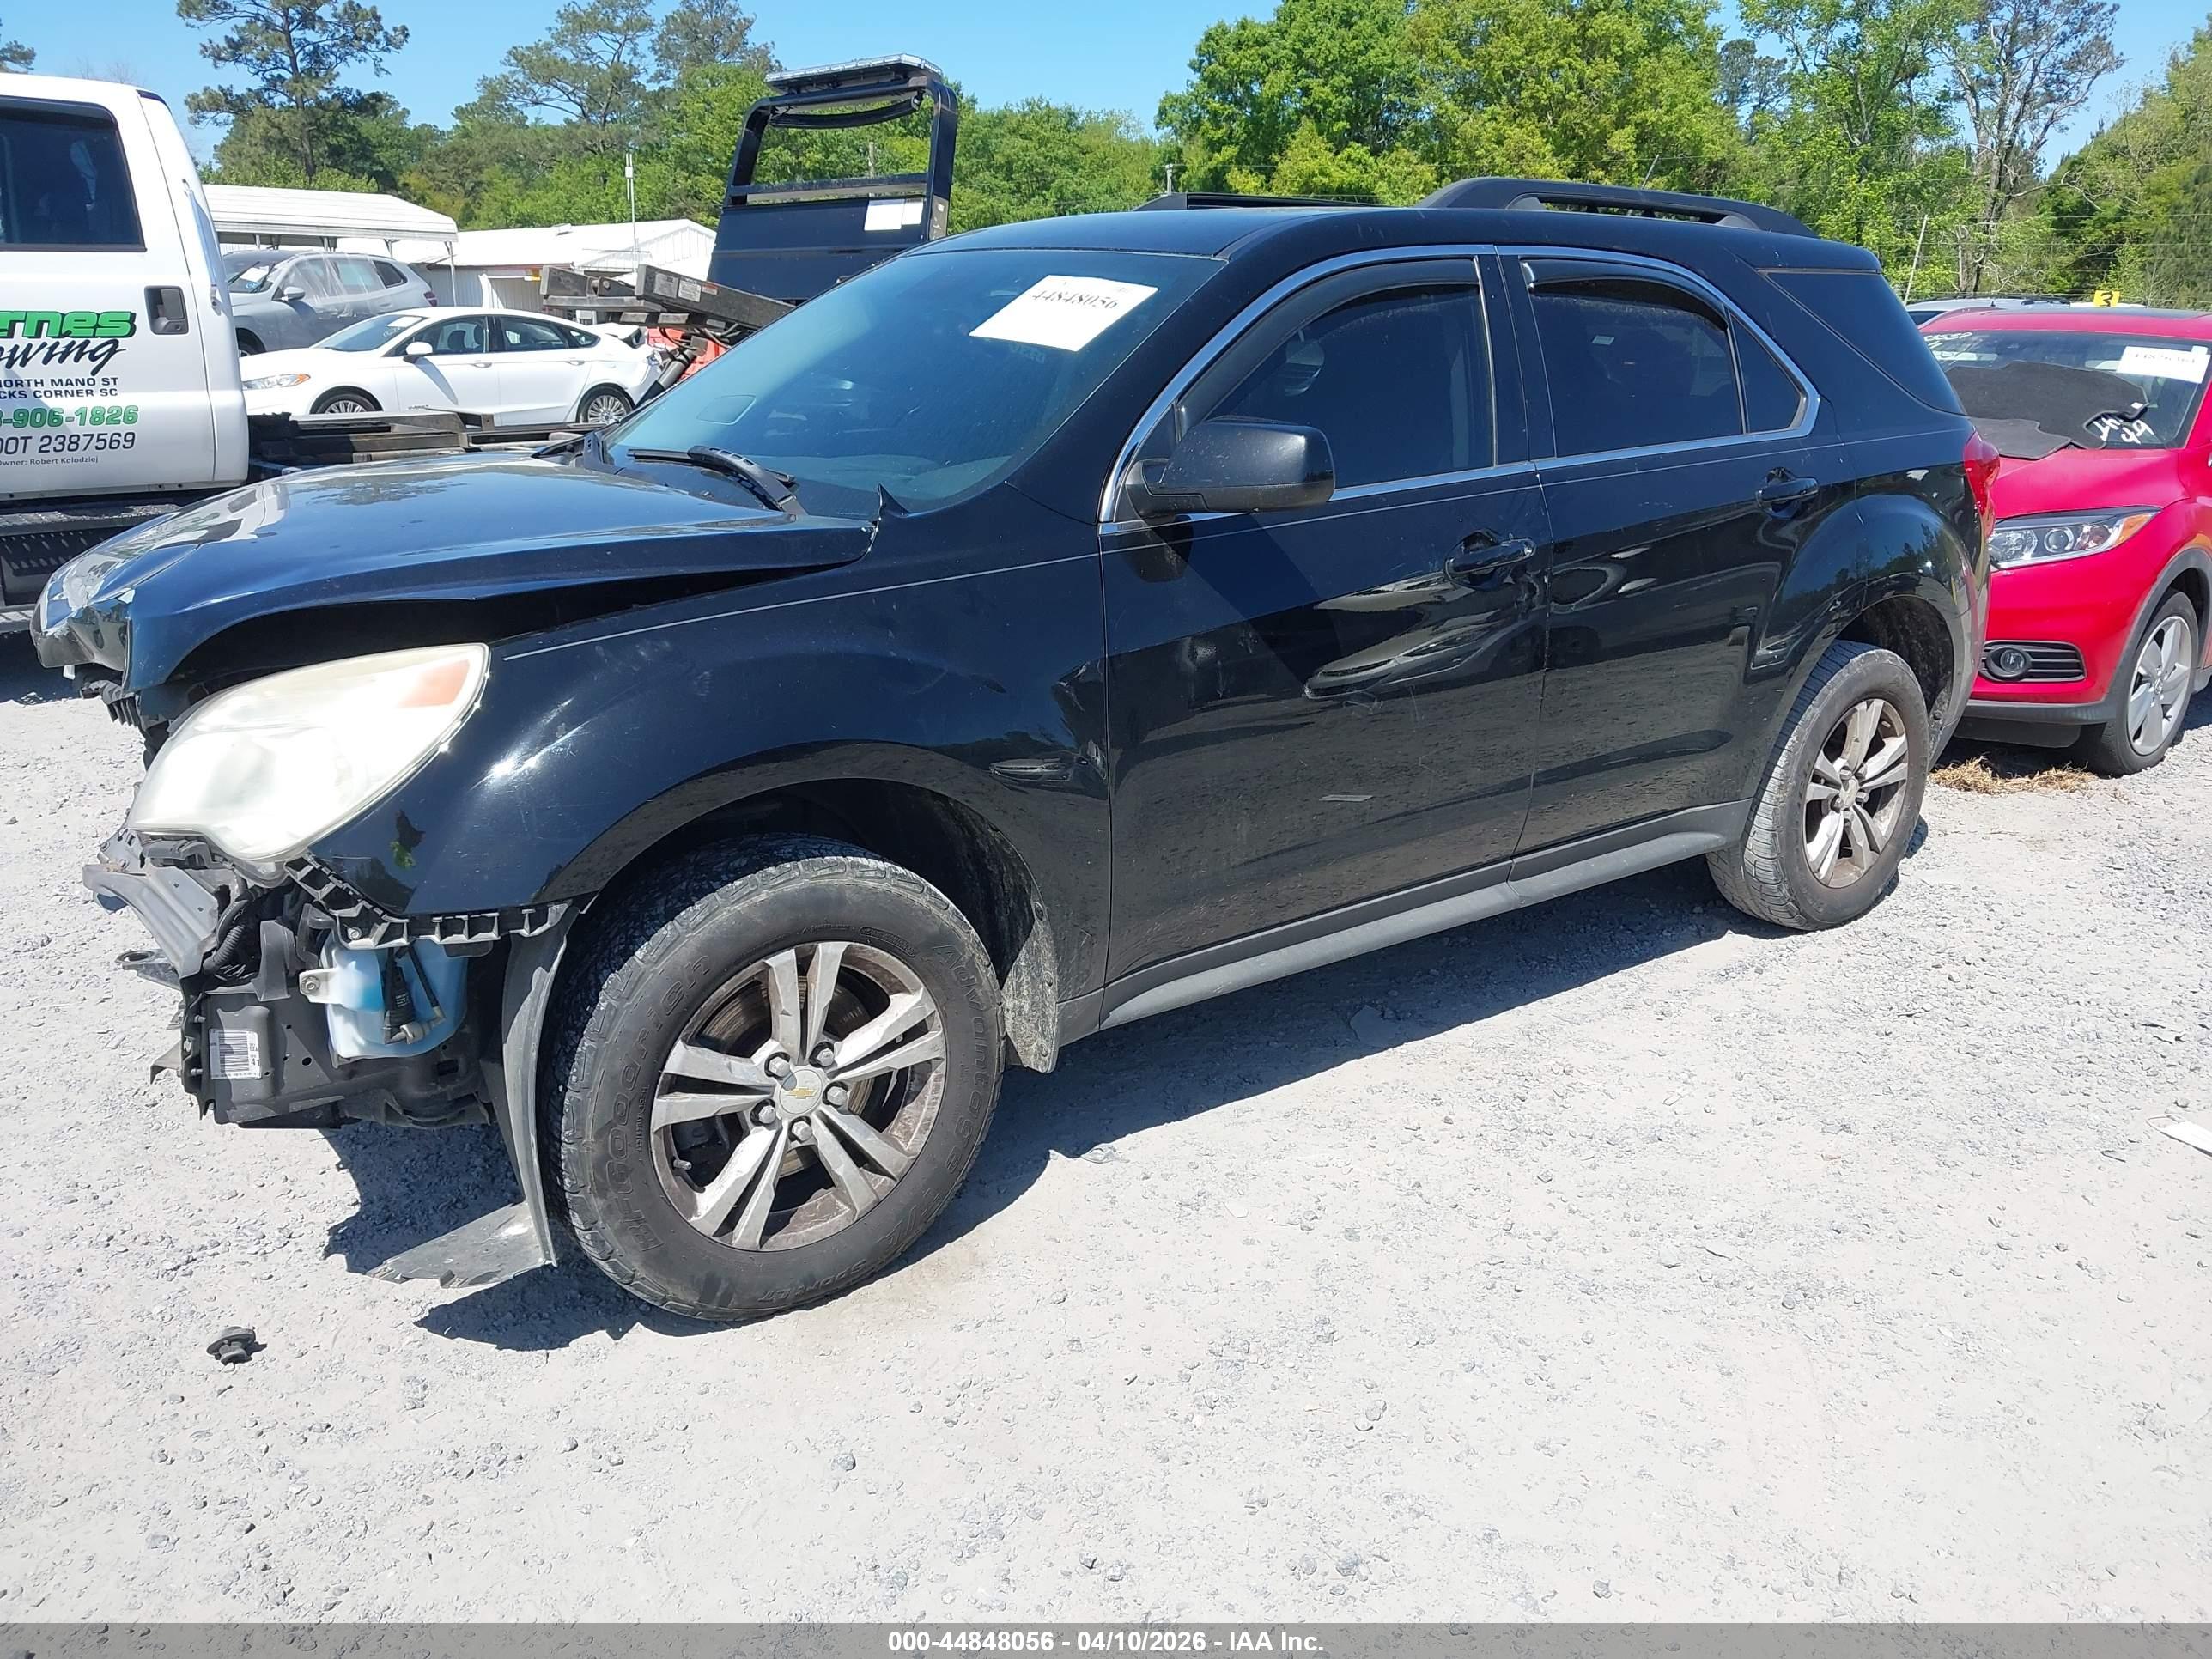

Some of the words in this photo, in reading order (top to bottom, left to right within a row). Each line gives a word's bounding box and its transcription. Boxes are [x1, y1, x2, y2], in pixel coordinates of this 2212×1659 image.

[1032, 289, 1117, 308] 44848056
[0, 379, 45, 388] ORTH
[50, 378, 96, 387] MANO
[101, 377, 118, 386] ST
[0, 390, 27, 399] CKS
[33, 389, 94, 398] CORNER
[100, 388, 118, 398] SC
[0, 405, 139, 428] -906-1826
[38, 432, 136, 454] 2387569
